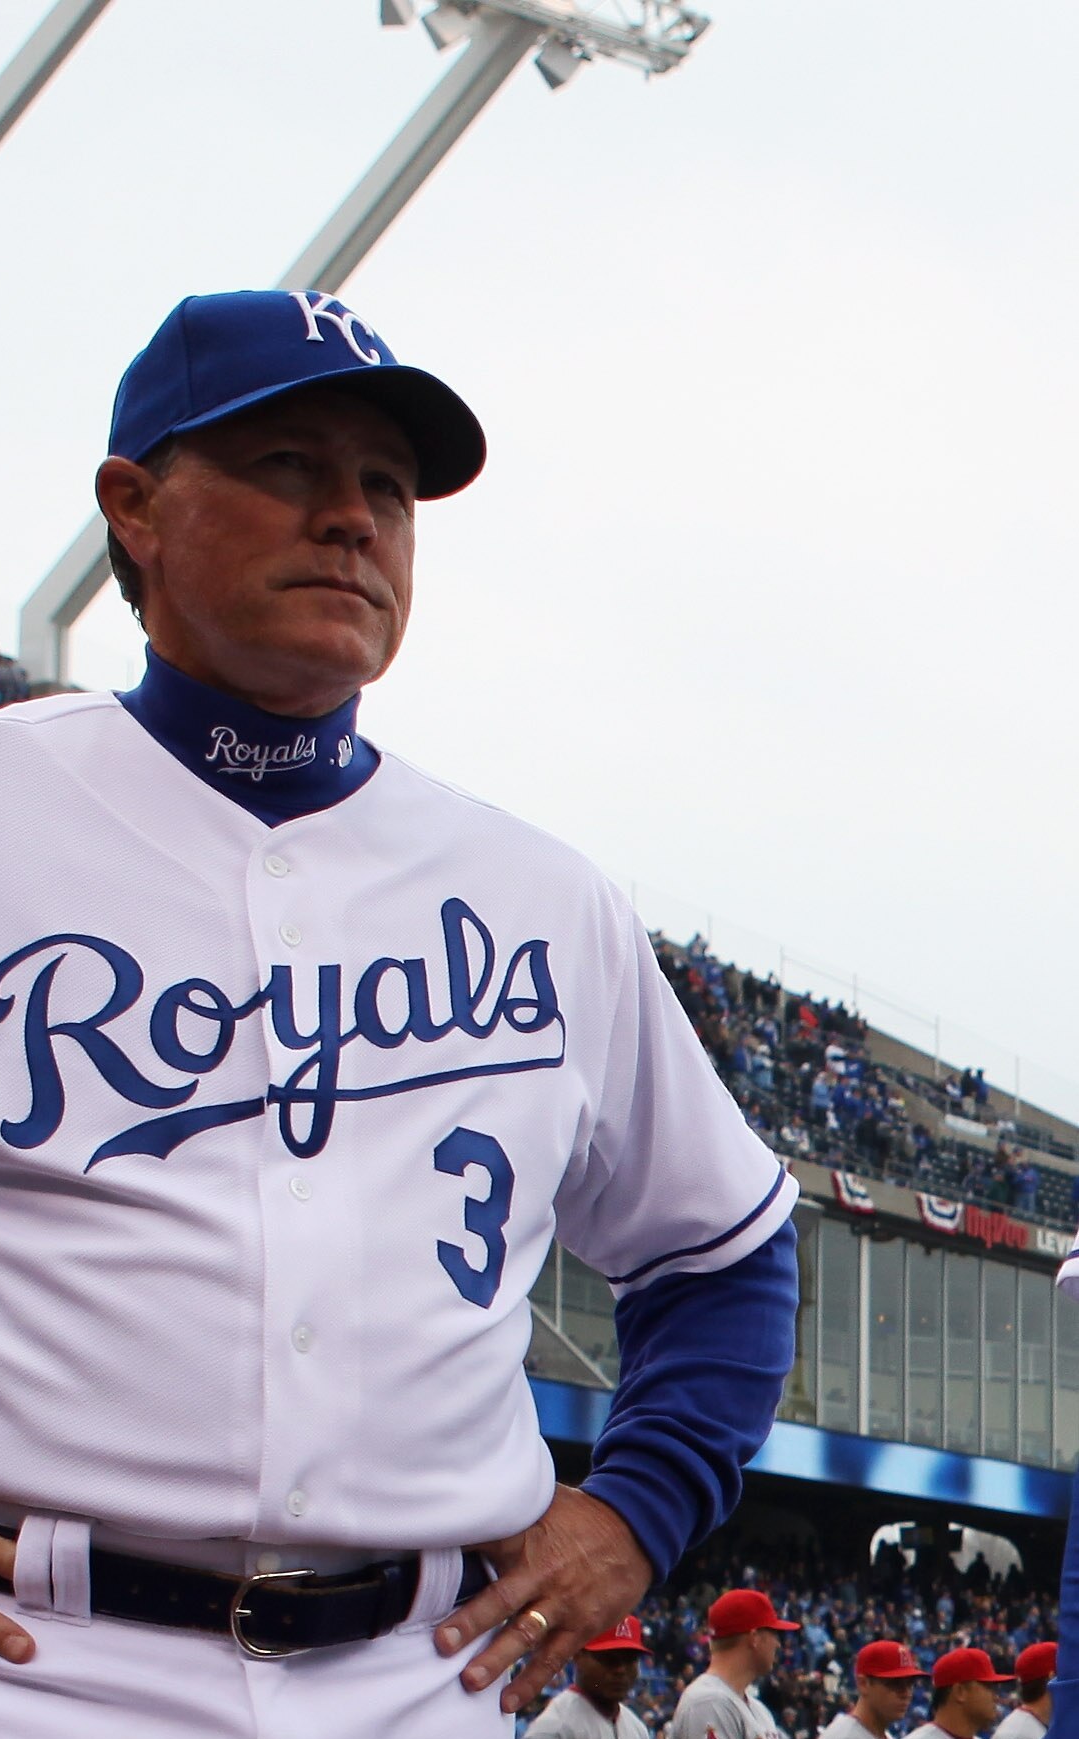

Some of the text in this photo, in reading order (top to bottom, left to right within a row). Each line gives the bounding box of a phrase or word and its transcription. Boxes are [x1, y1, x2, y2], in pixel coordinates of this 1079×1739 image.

[289, 292, 381, 365] KC
[205, 725, 317, 782] Royals
[433, 1126, 515, 1310] 3
